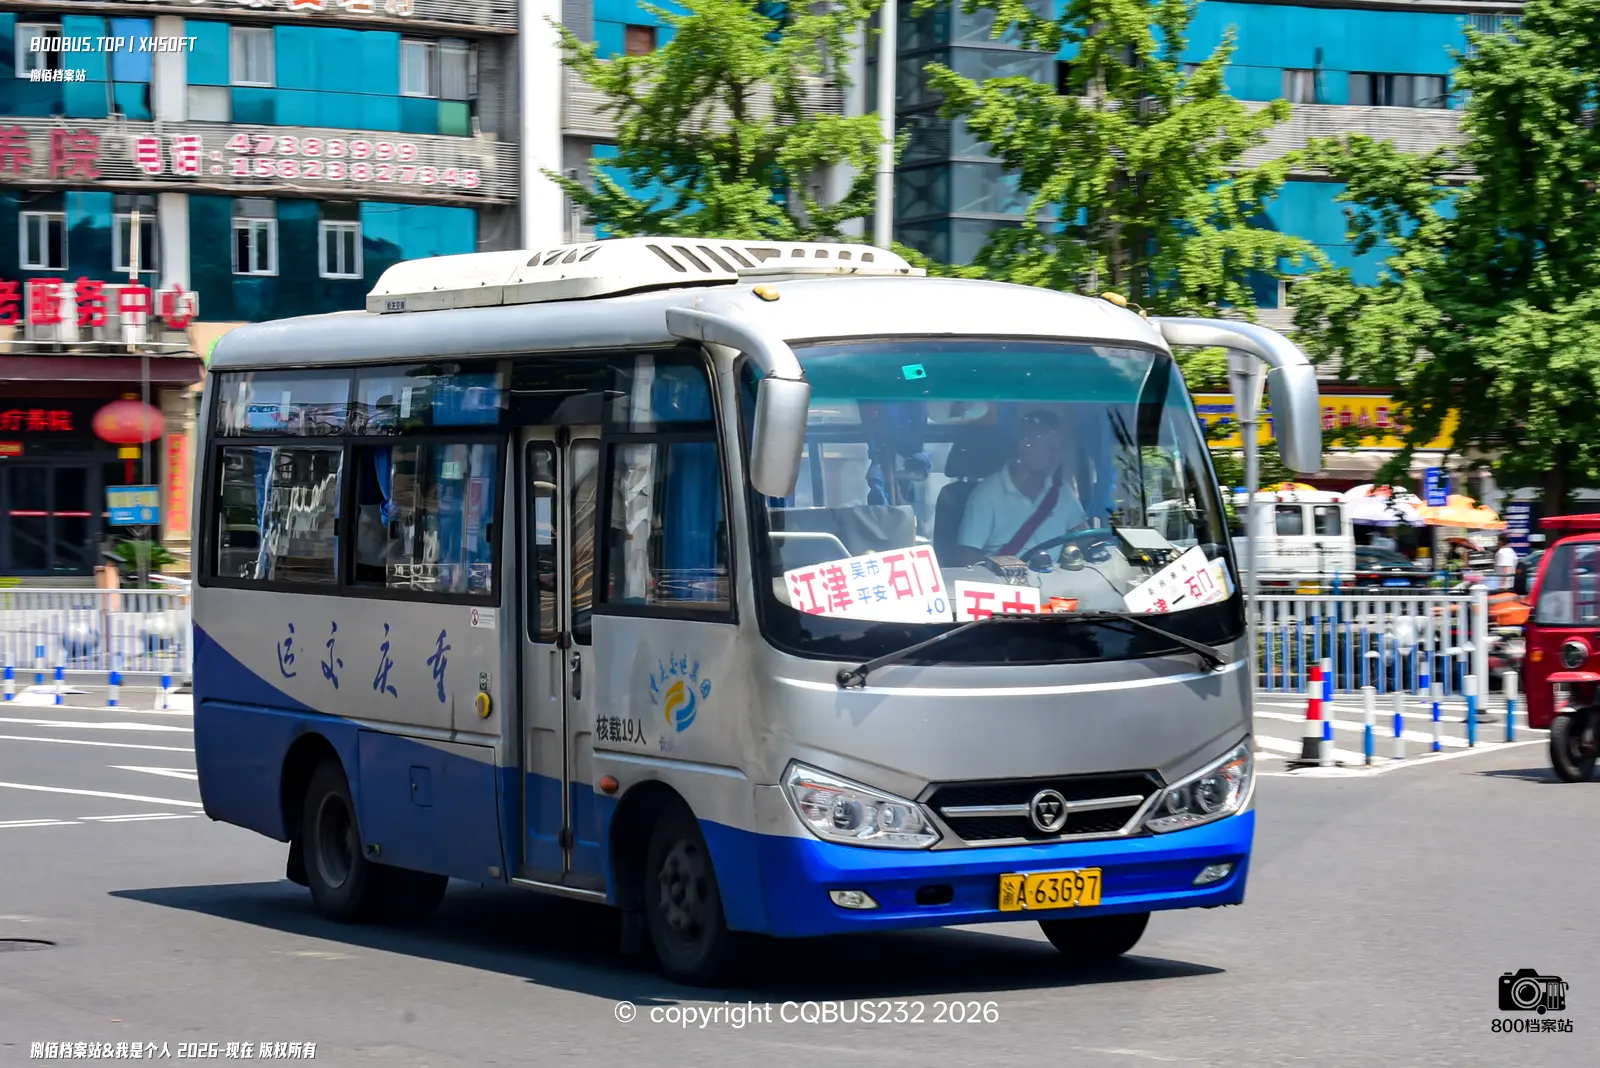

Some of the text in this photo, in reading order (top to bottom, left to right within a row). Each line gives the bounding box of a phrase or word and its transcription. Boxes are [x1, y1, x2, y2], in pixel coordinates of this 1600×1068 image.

[226, 133, 419, 162] 47383999
[229, 157, 481, 188] 15823827345
[790, 550, 940, 616] 江津 石门
[850, 559, 881, 580] 吴市
[857, 585, 888, 605] 平安
[596, 714, 647, 745] 核载19人
